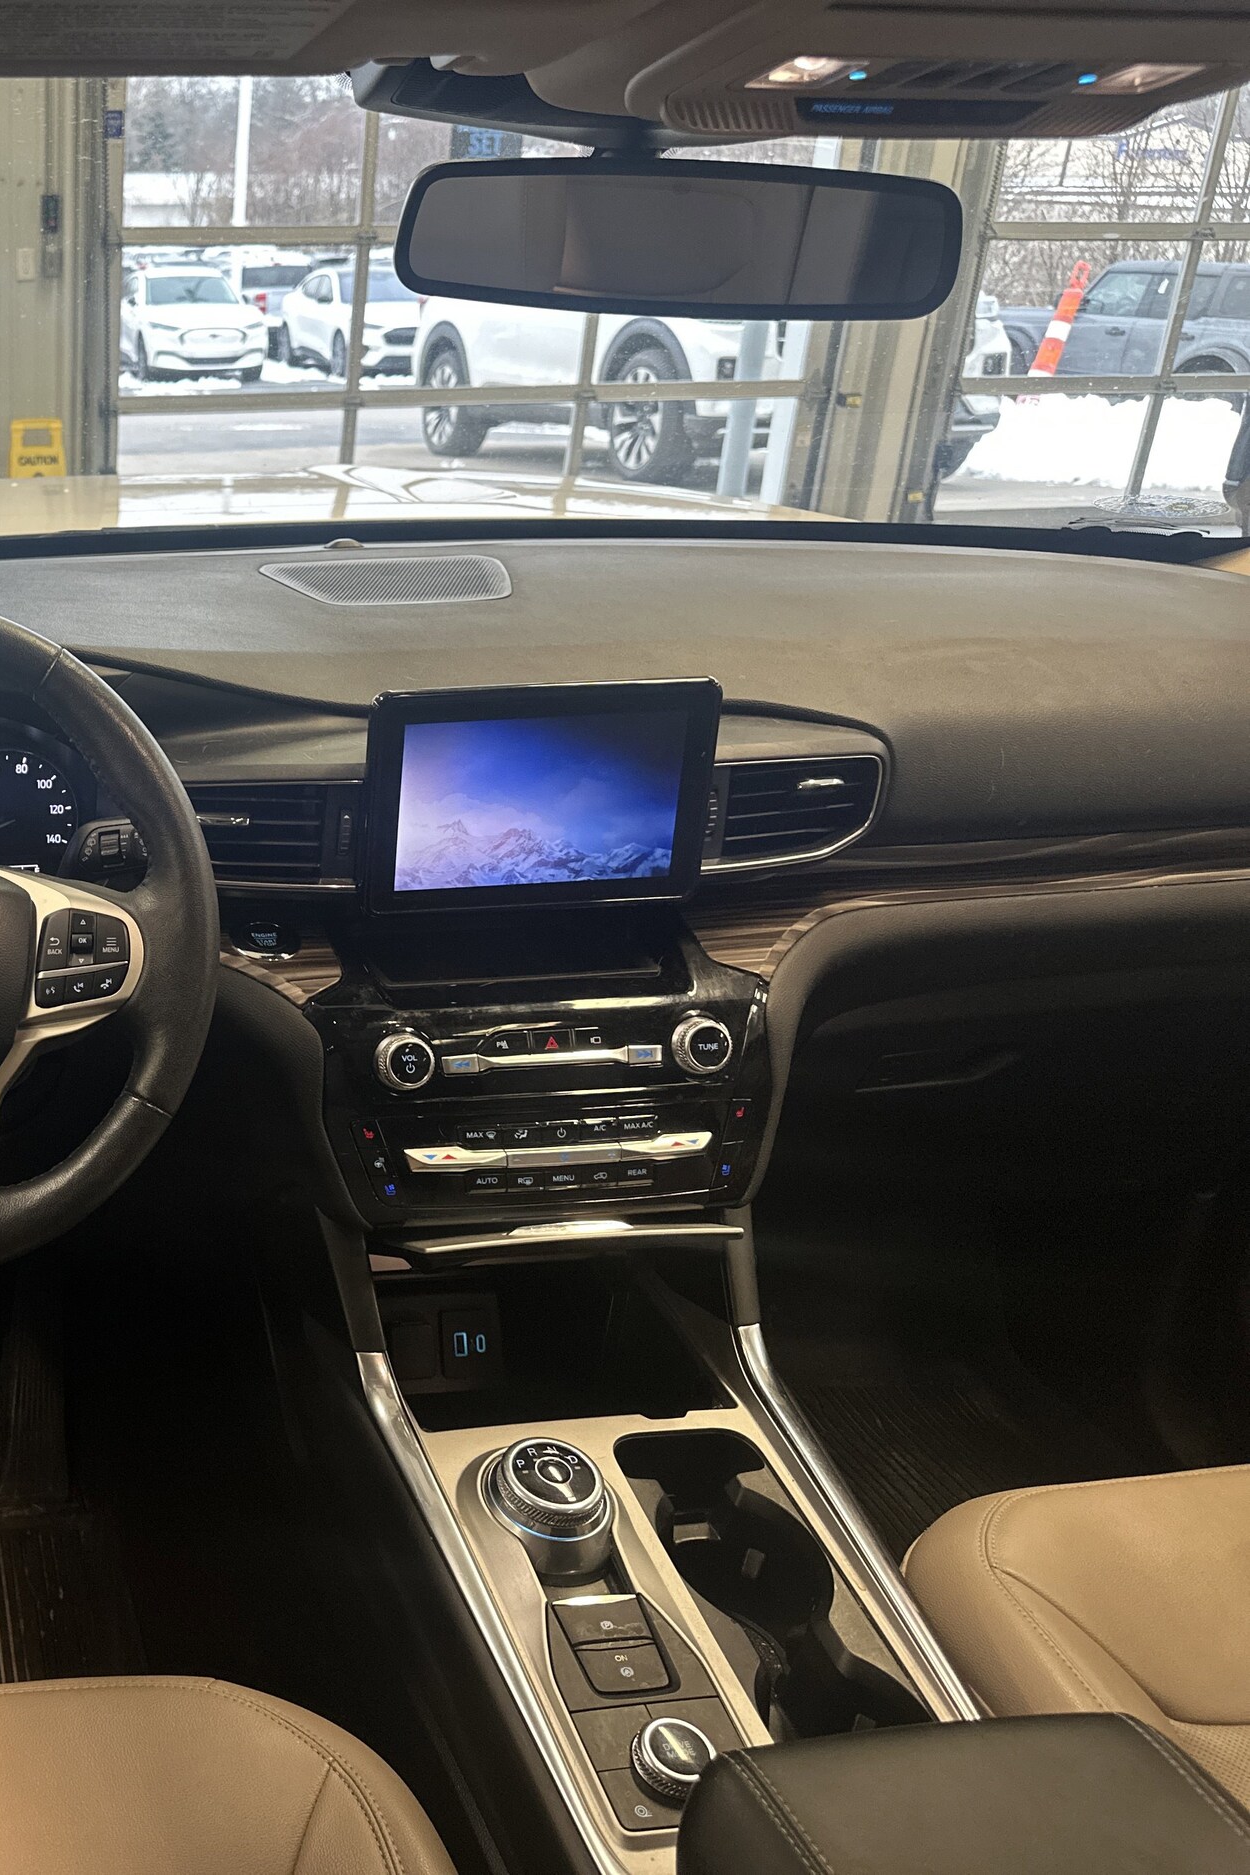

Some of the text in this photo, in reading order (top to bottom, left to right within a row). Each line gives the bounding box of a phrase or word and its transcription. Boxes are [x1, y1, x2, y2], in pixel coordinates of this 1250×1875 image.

[468, 131, 501, 157] SET
[15, 764, 28, 775] 80
[36, 779, 53, 790] 100
[49, 804, 64, 815] 120
[46, 833, 61, 844] 140
[102, 946, 120, 954] MENU
[698, 1042, 719, 1051] TUNE
[401, 1054, 418, 1062] VOL
[593, 1123, 607, 1132] A/C
[623, 1122, 641, 1130] MAX
[466, 1131, 484, 1139] MAX
[627, 1168, 647, 1176] REAR
[476, 1176, 498, 1185] AUTO
[552, 1174, 575, 1182] MENU
[527, 1447, 537, 1456] R
[516, 1459, 525, 1468] P
[614, 1654, 628, 1662] ON
[662, 1740, 691, 1751] DVE
